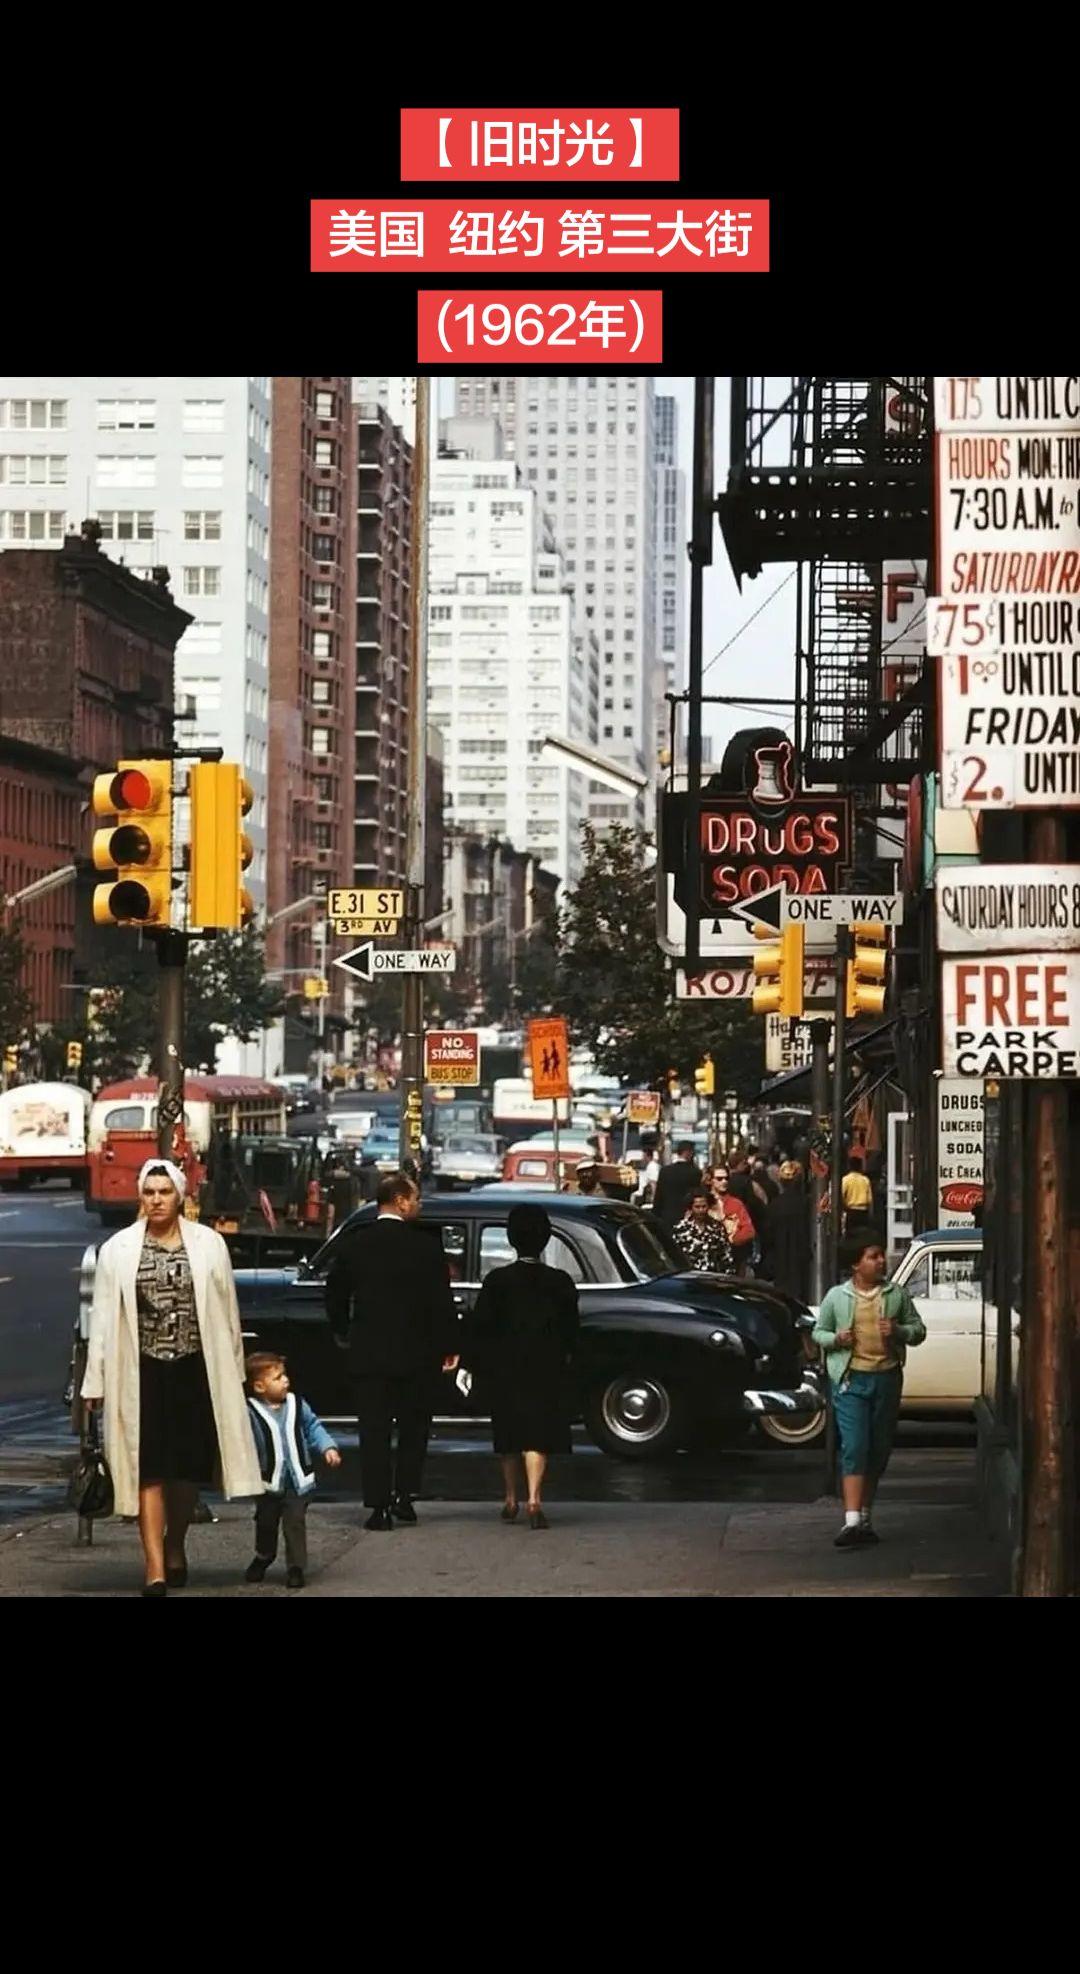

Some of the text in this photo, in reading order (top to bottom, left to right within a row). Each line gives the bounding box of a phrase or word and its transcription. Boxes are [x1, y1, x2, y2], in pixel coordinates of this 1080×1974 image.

[996, 377, 1060, 419] UNTIL
[948, 438, 1011, 480] HOURS
[950, 488, 1008, 530] 7:30
[1013, 486, 1060, 530] A.M.
[1060, 496, 1073, 515] to
[951, 551, 1060, 594] SATURDAY
[1013, 601, 1073, 645] HOUR
[1003, 652, 1068, 696] UNTIL
[965, 706, 1080, 745] FRIDAY
[1024, 752, 1080, 794] UNTI
[701, 812, 840, 856] DRUGS
[712, 864, 828, 902] SODA
[377, 893, 400, 914] ST
[788, 899, 897, 920] ONE WAY
[943, 885, 1014, 928] SATURDAY
[1018, 884, 1068, 928] HOURS
[373, 921, 392, 933] AV
[374, 953, 450, 969] ONE WAY
[956, 965, 1070, 1027] FREE
[431, 1048, 474, 1060] STANDING
[442, 1038, 463, 1049] NO
[956, 1031, 1058, 1049] PARK
[431, 1067, 473, 1079] BUS STOP
[957, 1051, 1080, 1077] CARPE
[941, 1121, 983, 1132] LUNCHEO
[947, 1143, 982, 1154] SODA
[957, 1165, 983, 1179] CREA
